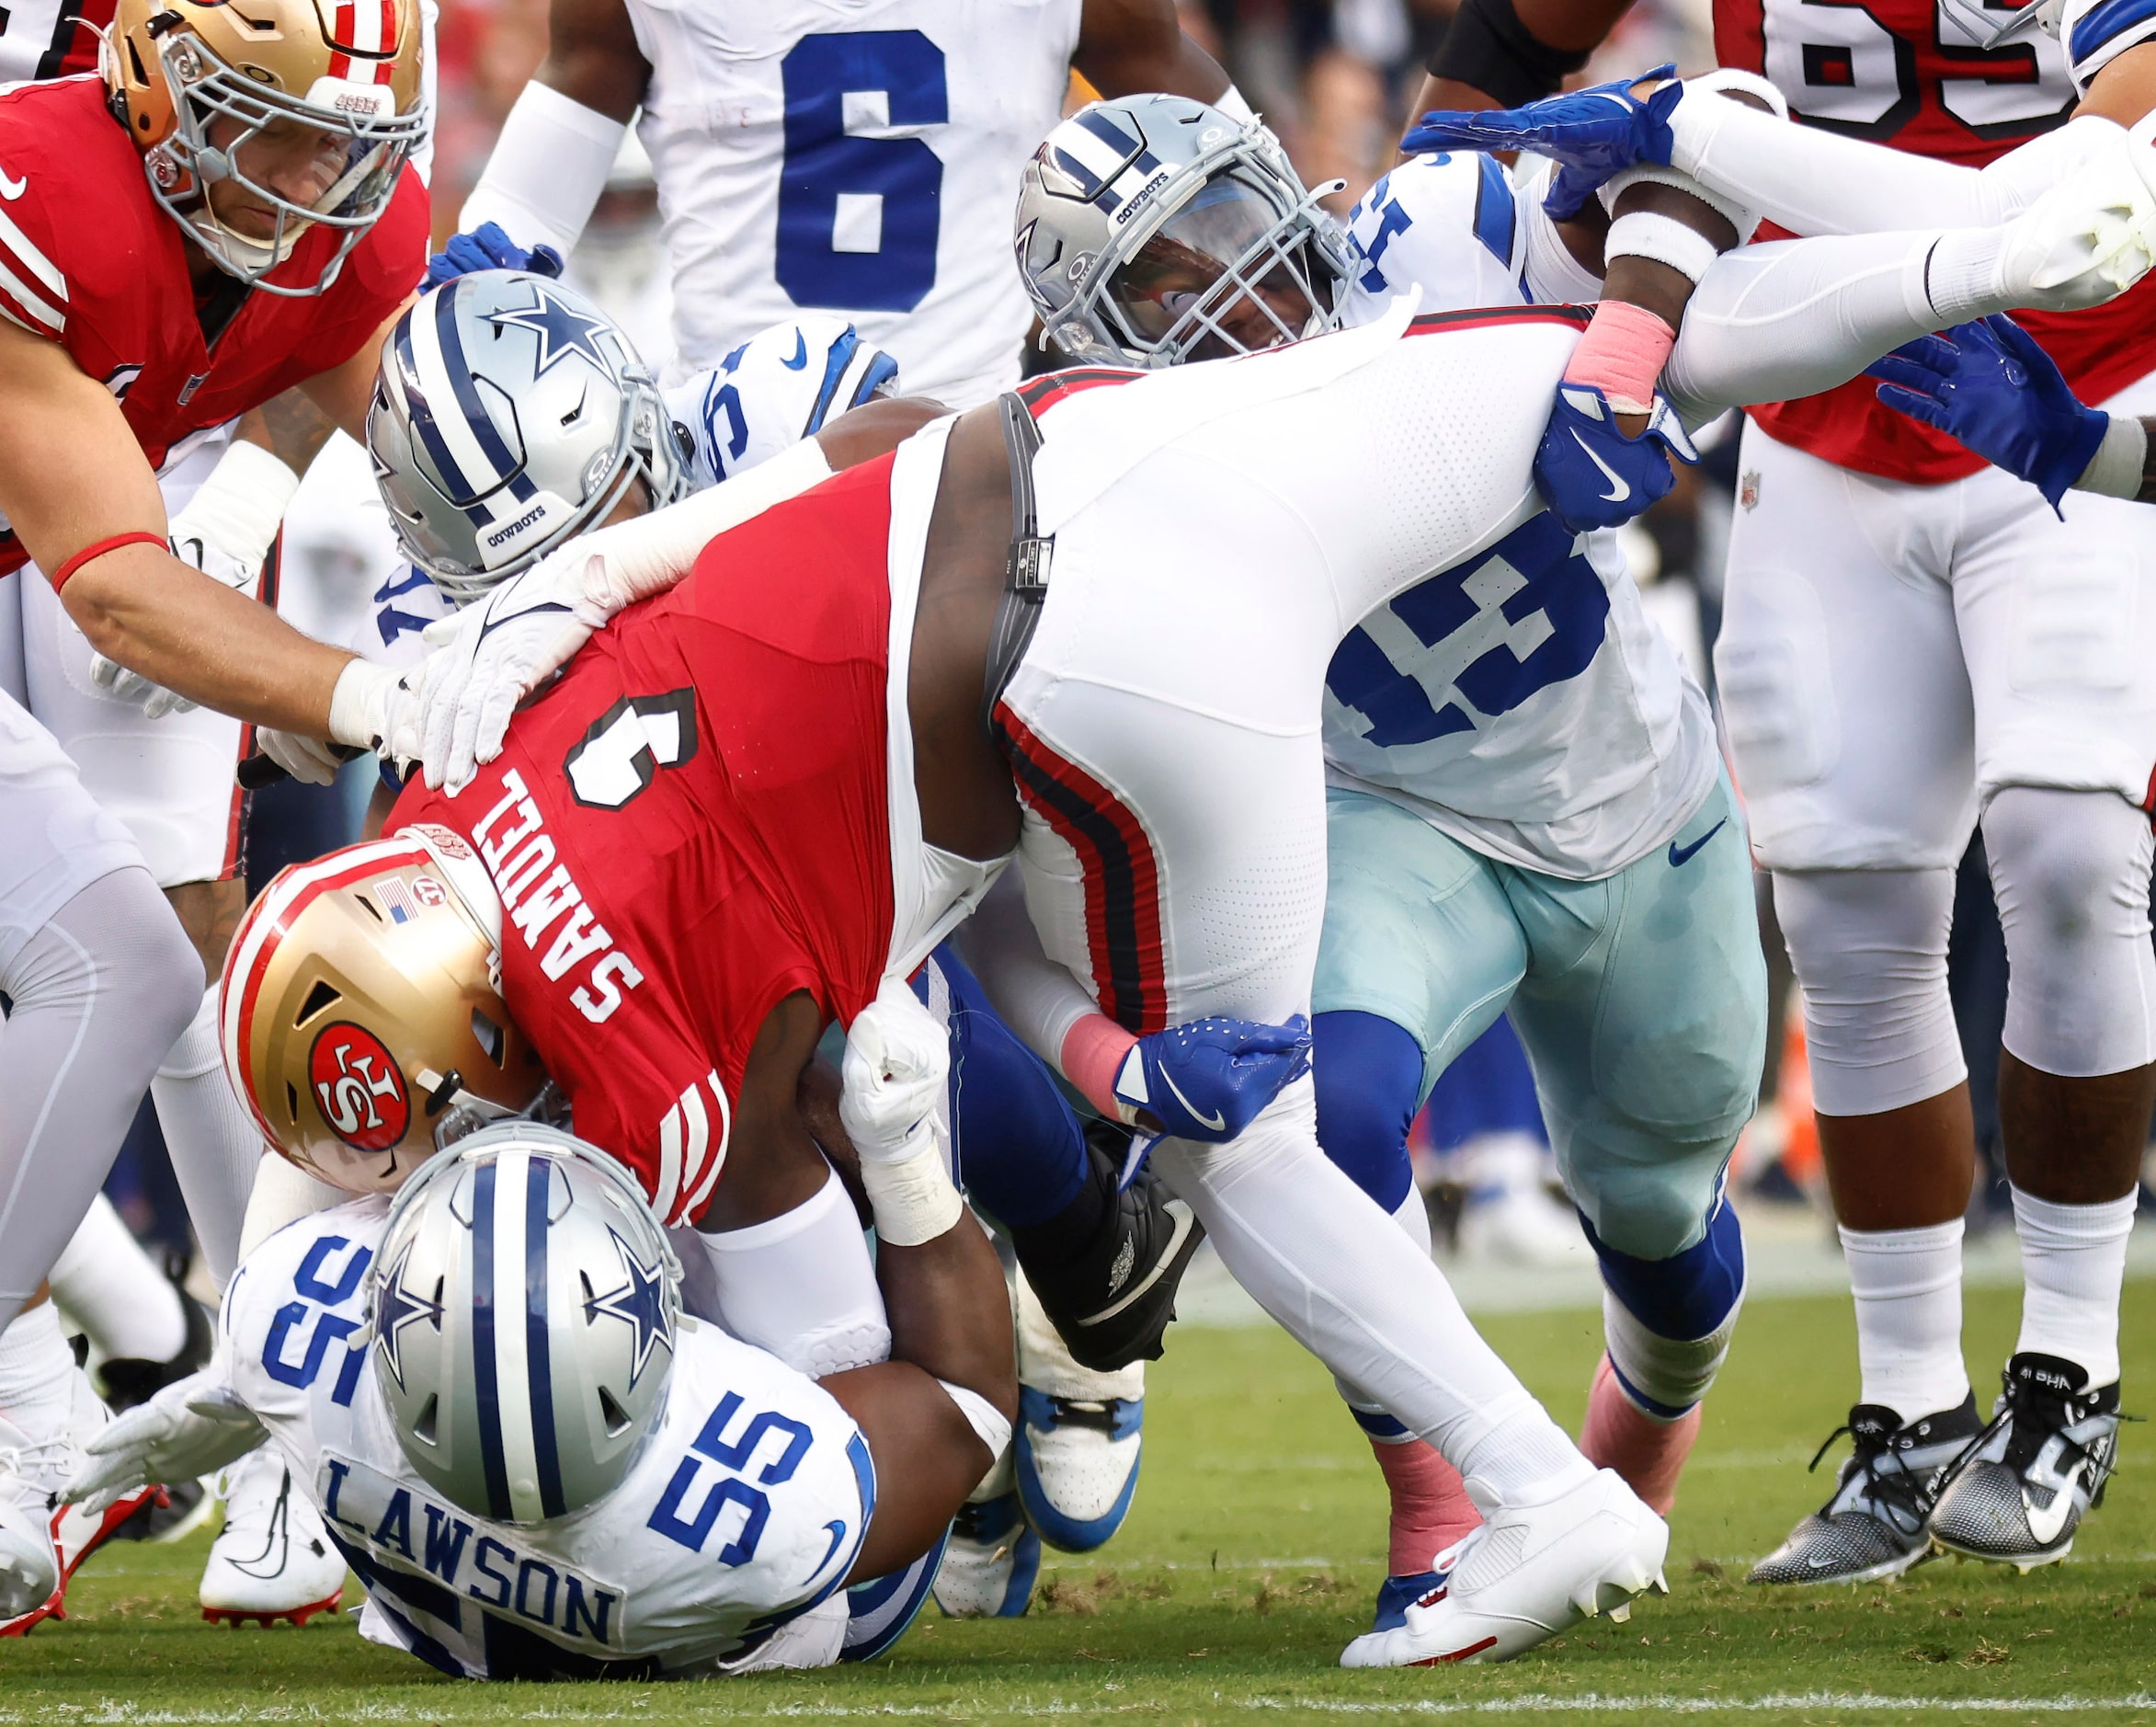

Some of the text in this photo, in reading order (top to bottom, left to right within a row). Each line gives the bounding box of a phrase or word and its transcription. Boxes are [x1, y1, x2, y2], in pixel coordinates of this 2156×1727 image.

[775, 29, 949, 314] 6
[1115, 172, 1169, 225] COWBOYS
[486, 505, 547, 548] COWBOYS
[471, 767, 645, 1024] SAMUEL
[324, 1458, 617, 1645] LAWSON
[646, 1390, 815, 1569] 55
